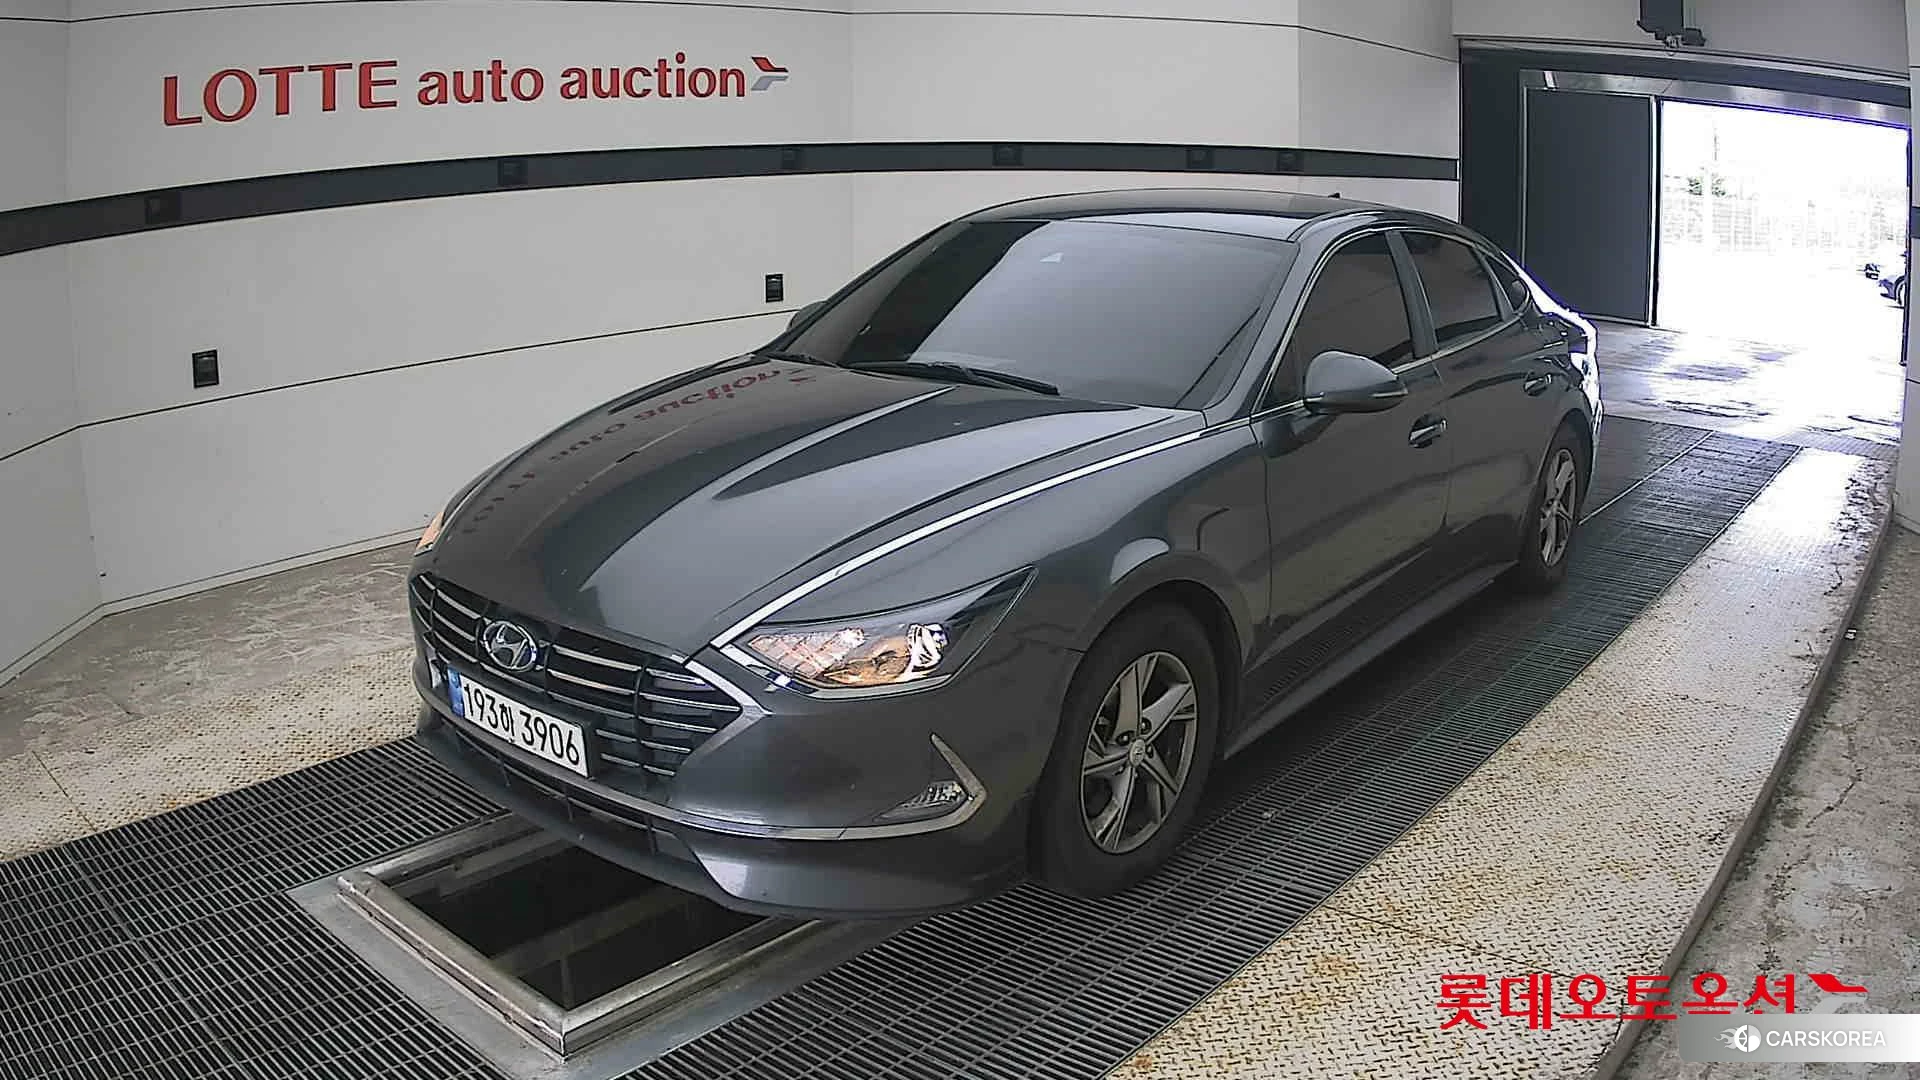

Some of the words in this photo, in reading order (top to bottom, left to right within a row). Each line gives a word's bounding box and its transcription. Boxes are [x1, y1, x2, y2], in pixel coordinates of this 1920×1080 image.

[163, 59, 398, 126] LOTTE
[417, 60, 544, 106] auto
[559, 52, 746, 100] auction
[519, 710, 580, 766] 3906
